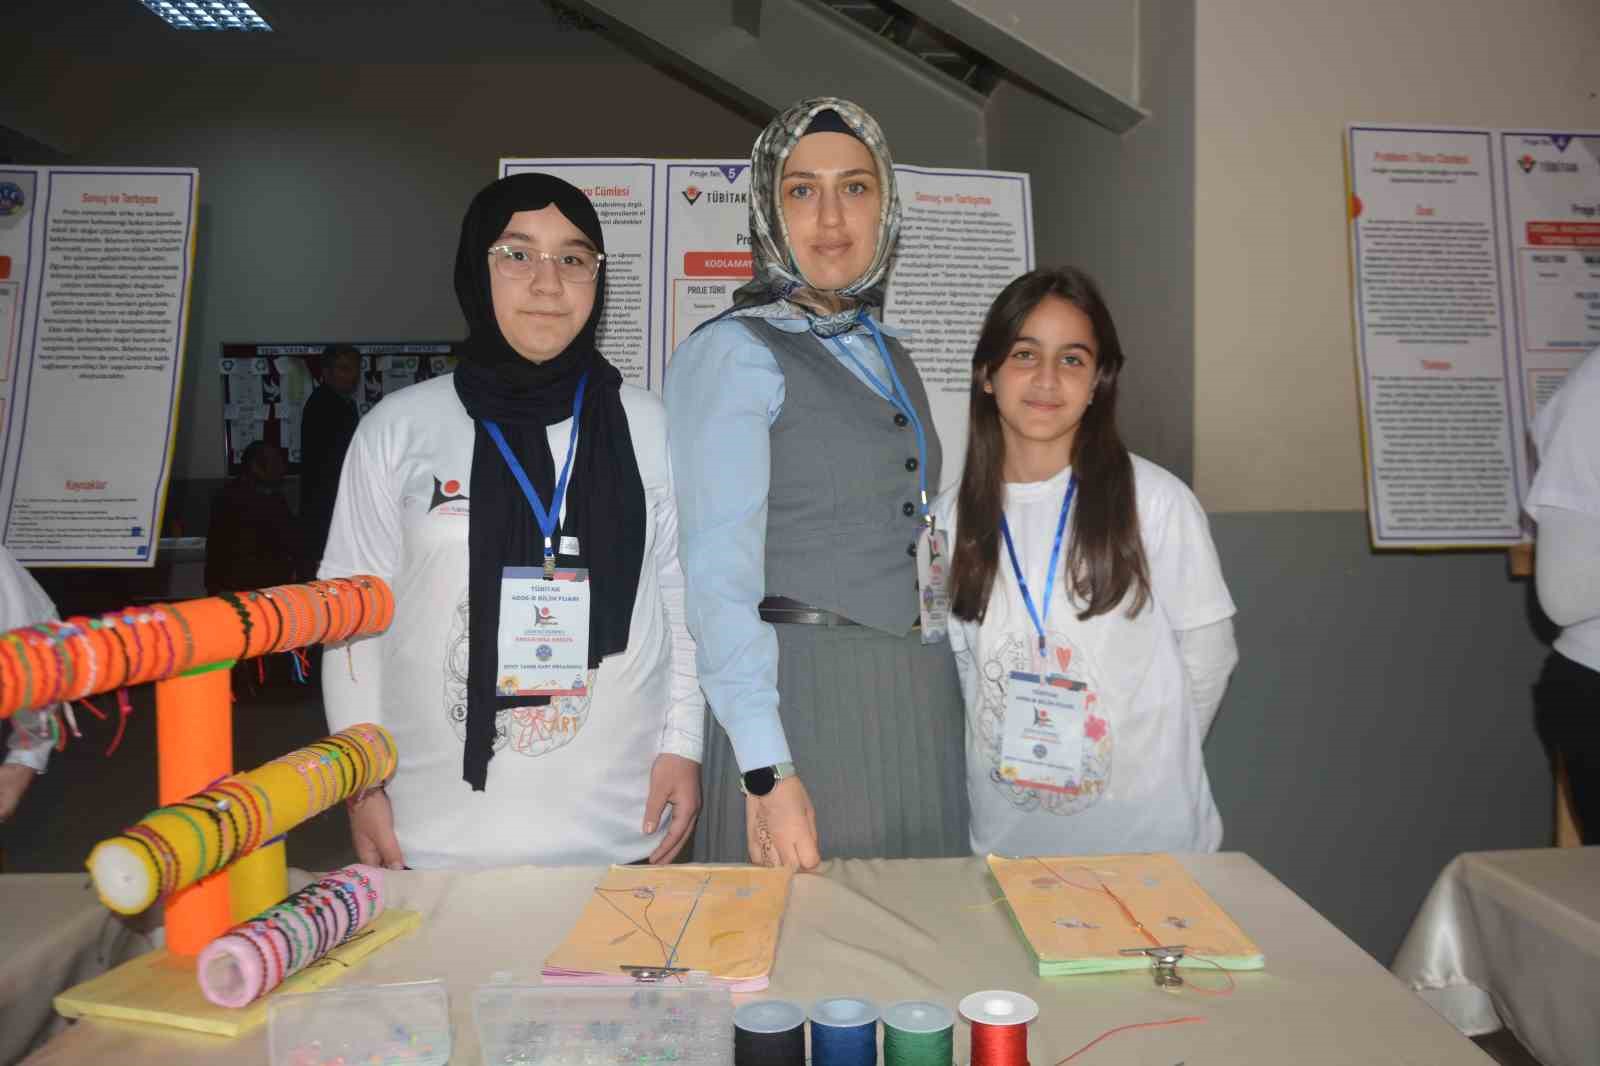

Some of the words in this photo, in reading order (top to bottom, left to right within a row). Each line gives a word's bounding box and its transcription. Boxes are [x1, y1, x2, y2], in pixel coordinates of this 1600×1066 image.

[727, 168, 736, 179] 5
[706, 190, 747, 203] TÜBİTAK
[687, 286, 708, 294] PROJE
